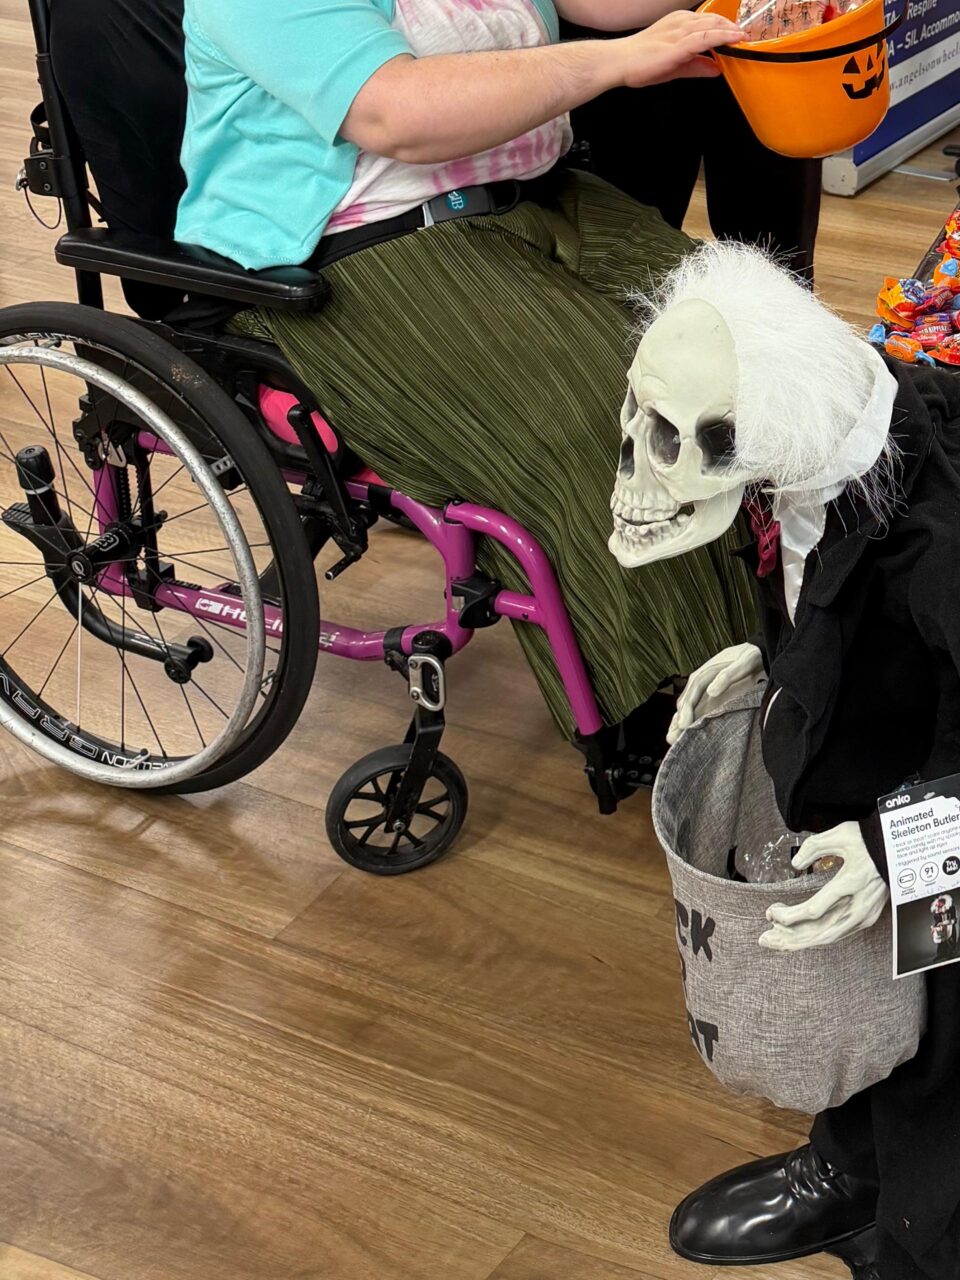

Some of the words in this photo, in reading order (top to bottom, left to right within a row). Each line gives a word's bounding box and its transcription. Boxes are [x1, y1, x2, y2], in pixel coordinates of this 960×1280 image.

[904, 28, 919, 49] SIL
[885, 794, 911, 809] anko
[889, 808, 934, 830] Animated
[891, 822, 932, 841] Skeleton
[932, 814, 960, 828] Butler
[924, 866, 934, 875] 91
